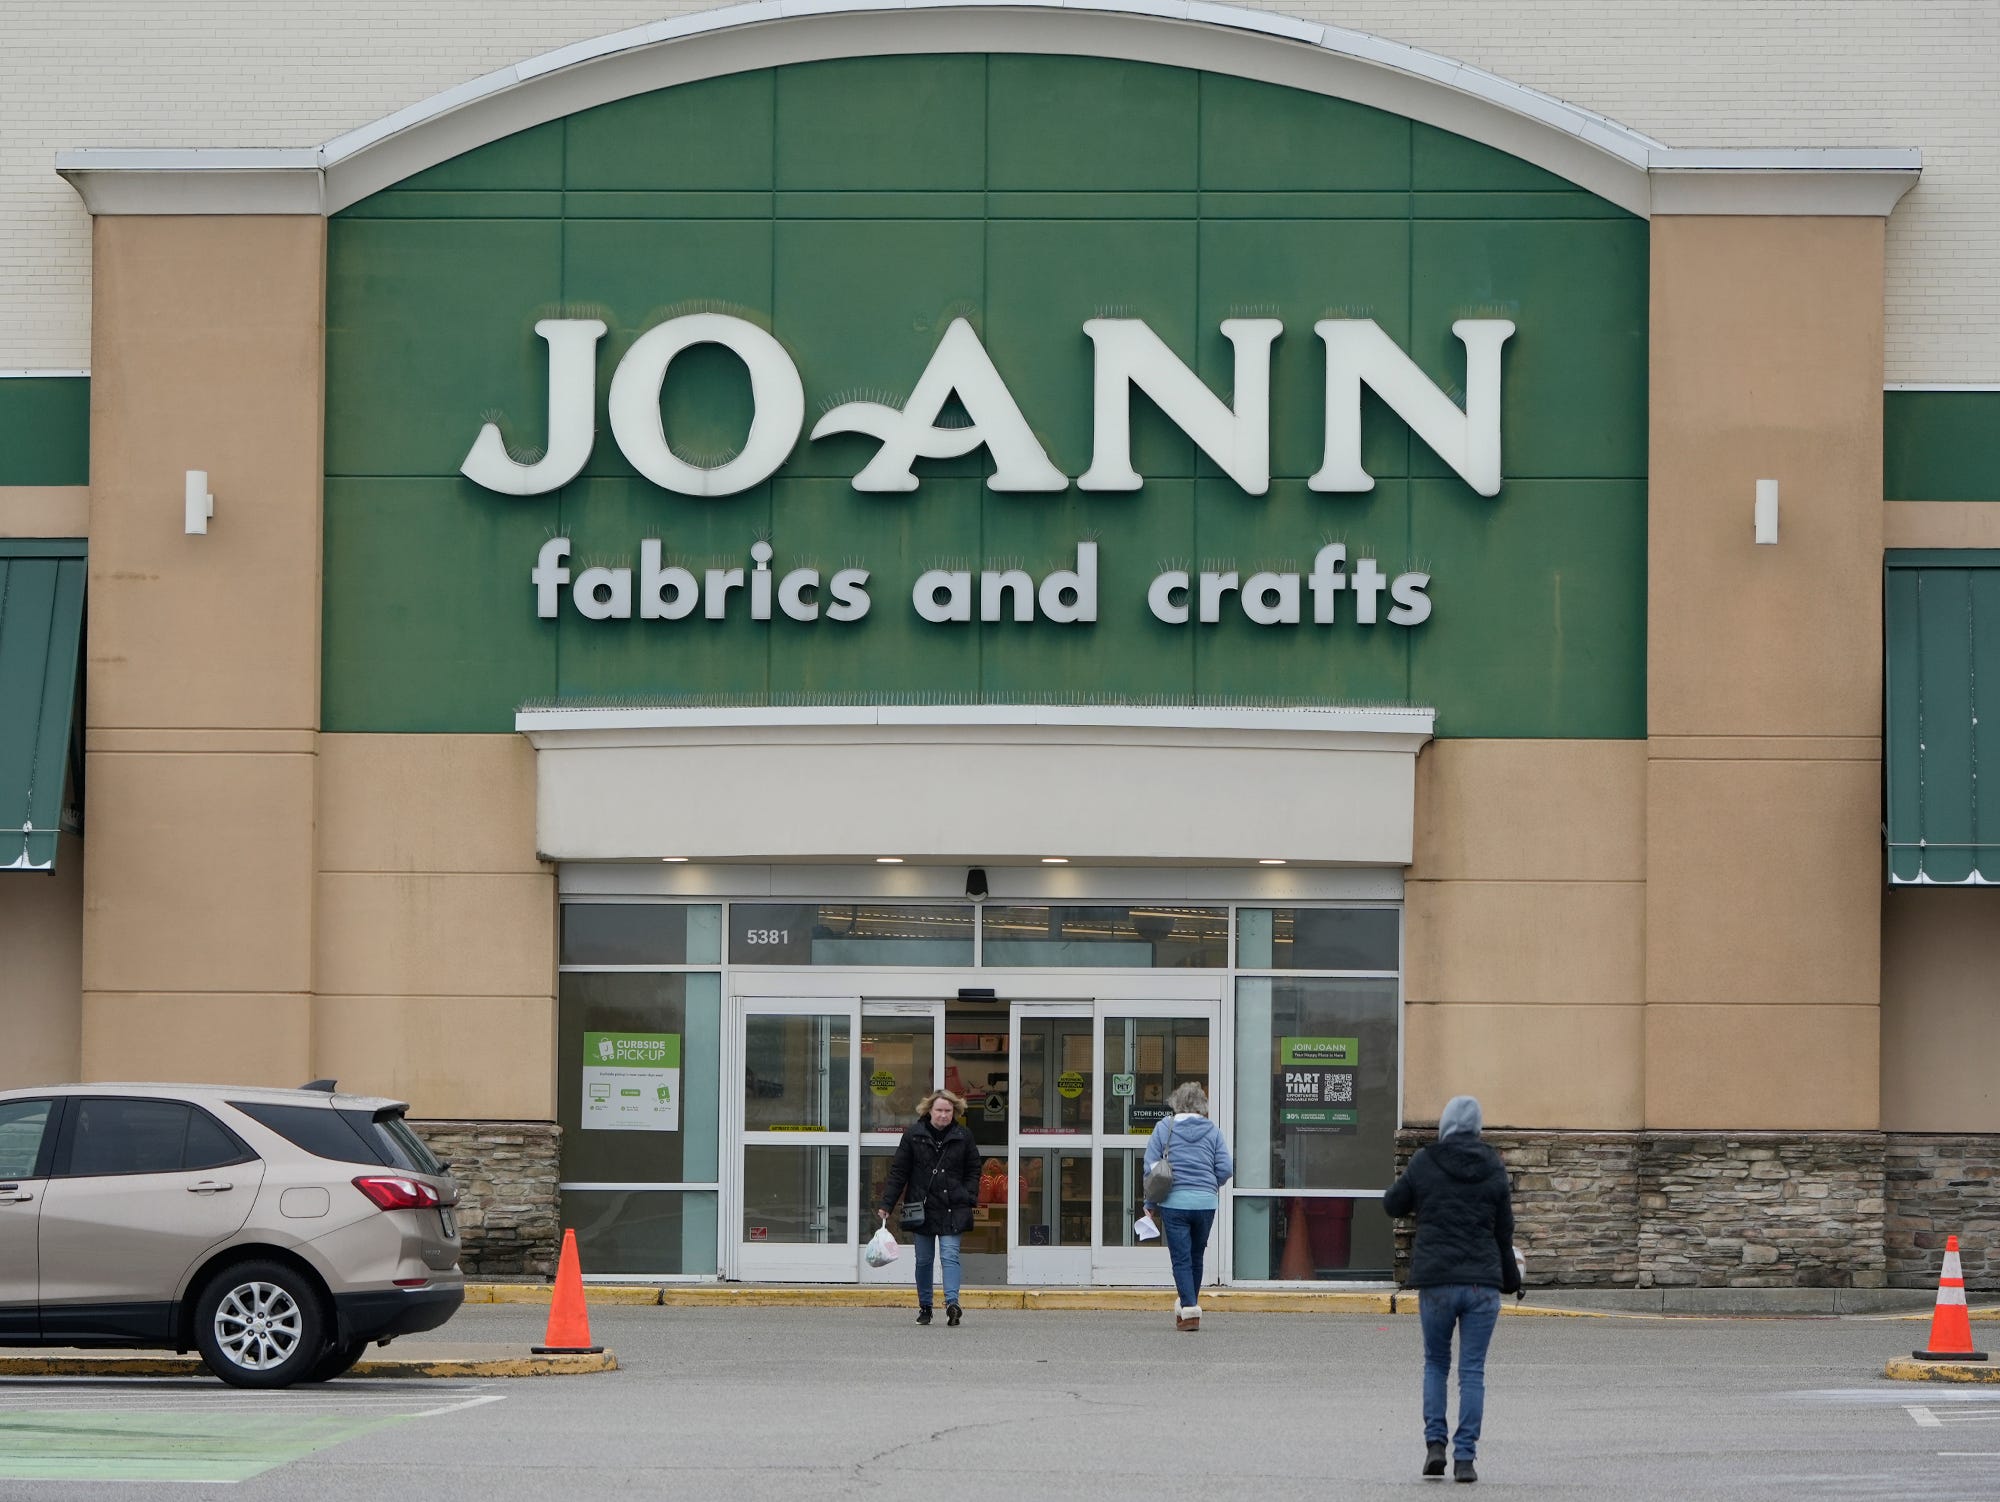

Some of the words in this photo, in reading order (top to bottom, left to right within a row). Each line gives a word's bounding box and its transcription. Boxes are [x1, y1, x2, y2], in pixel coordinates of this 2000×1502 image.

[531, 536, 872, 622] fabrics
[912, 541, 1098, 623] and
[1147, 542, 1432, 626] crafts
[747, 929, 788, 945] 5381
[617, 1040, 666, 1049] CURBSIDE
[1292, 1043, 1312, 1051] JOIN
[1313, 1044, 1346, 1052] JOANN
[617, 1049, 666, 1061] PICK-UP
[1285, 1072, 1320, 1083] PART
[1286, 1083, 1319, 1093] TIME
